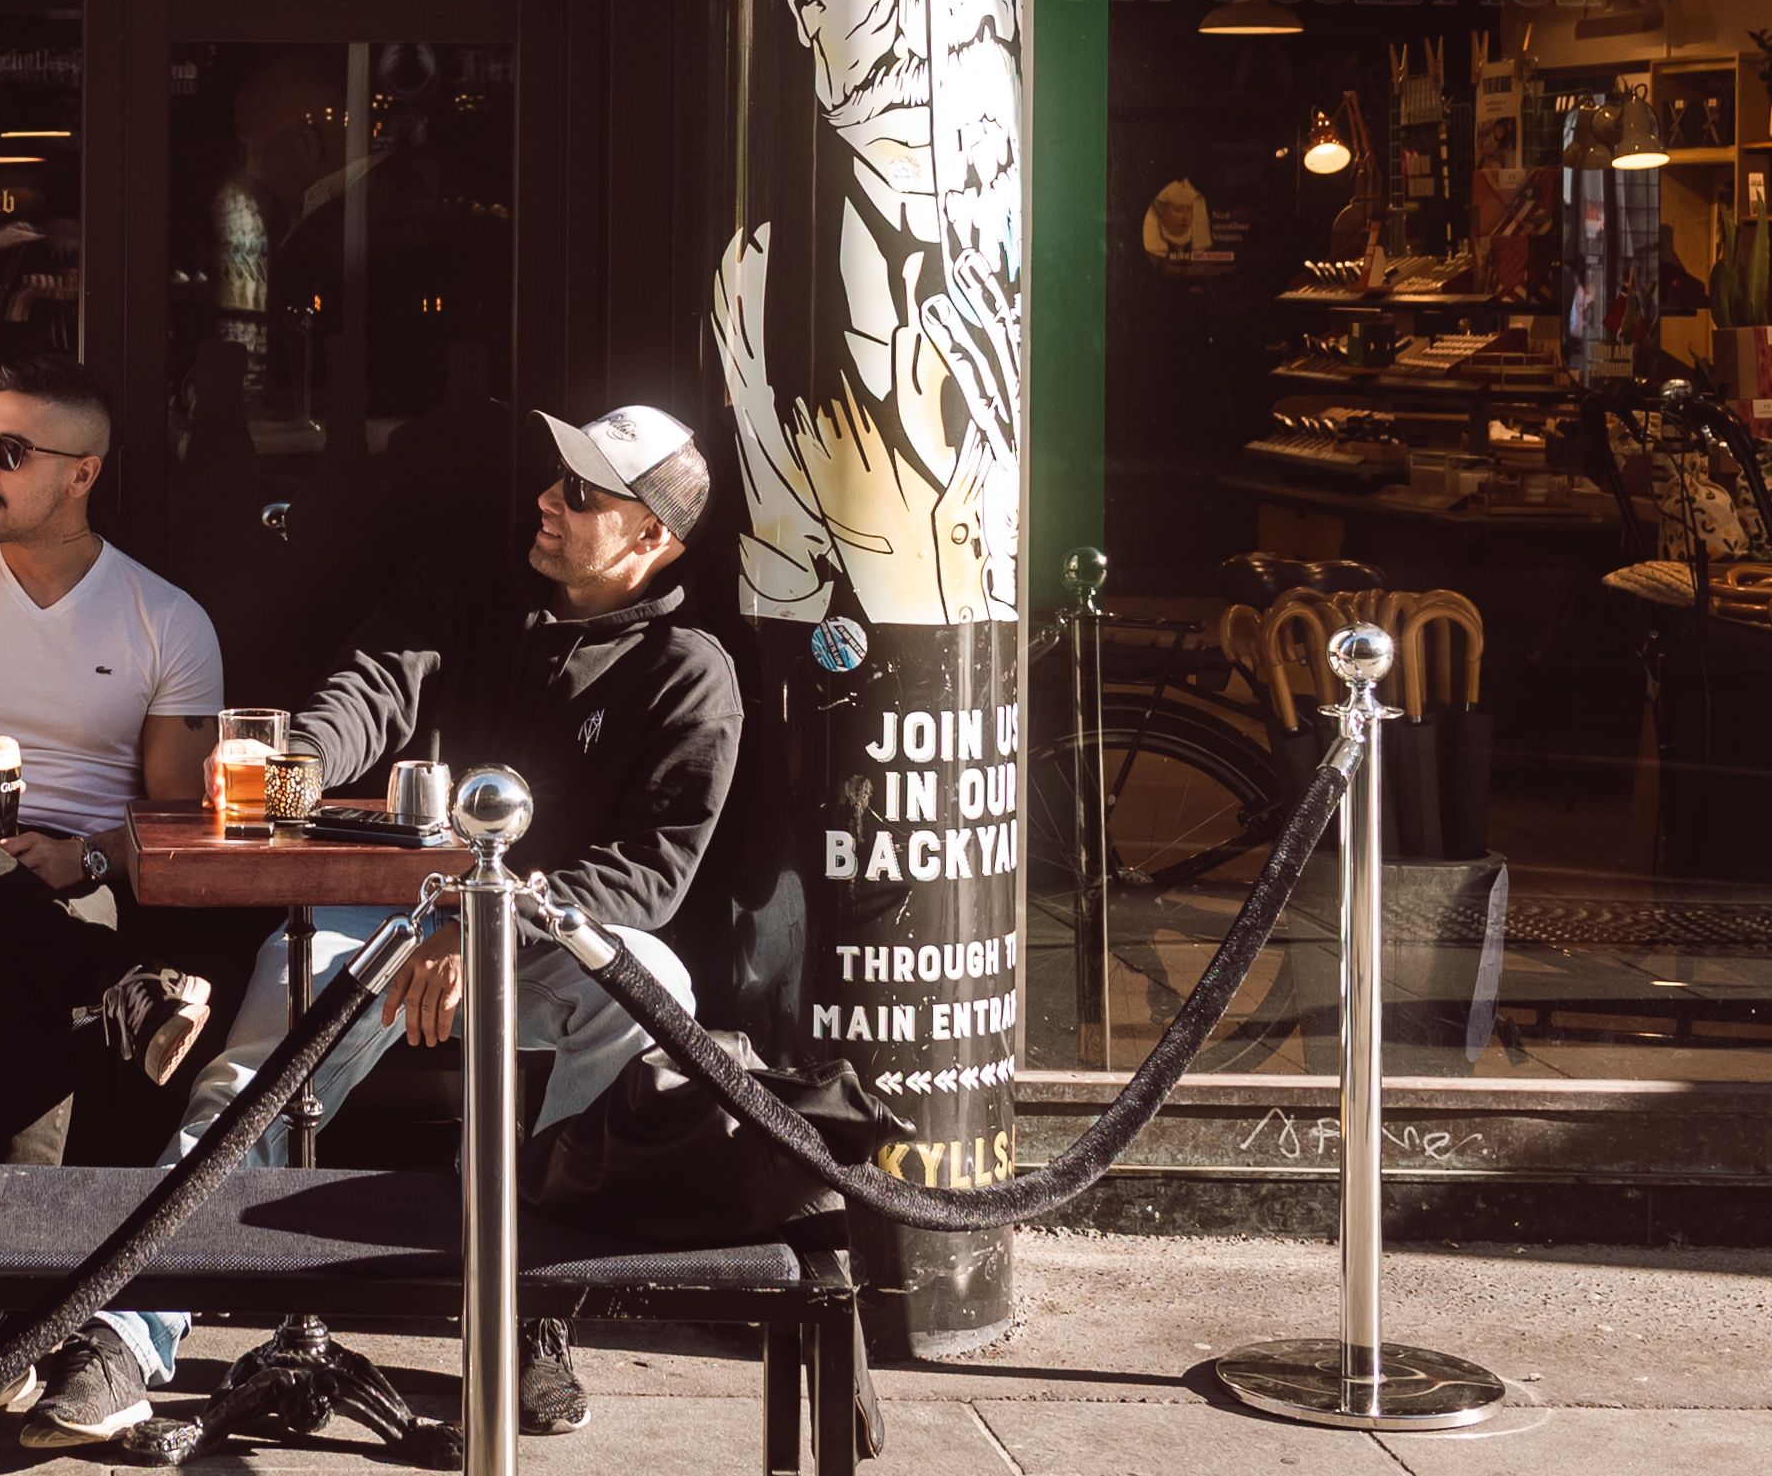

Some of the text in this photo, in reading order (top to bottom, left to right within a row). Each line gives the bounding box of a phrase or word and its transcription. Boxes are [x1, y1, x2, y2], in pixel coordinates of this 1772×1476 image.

[865, 709, 983, 763] JOIN
[884, 771, 938, 822] IN
[836, 937, 1000, 983] THROUGH
[812, 1004, 917, 1042] MAIN
[878, 1130, 1008, 1188] KYLLS
